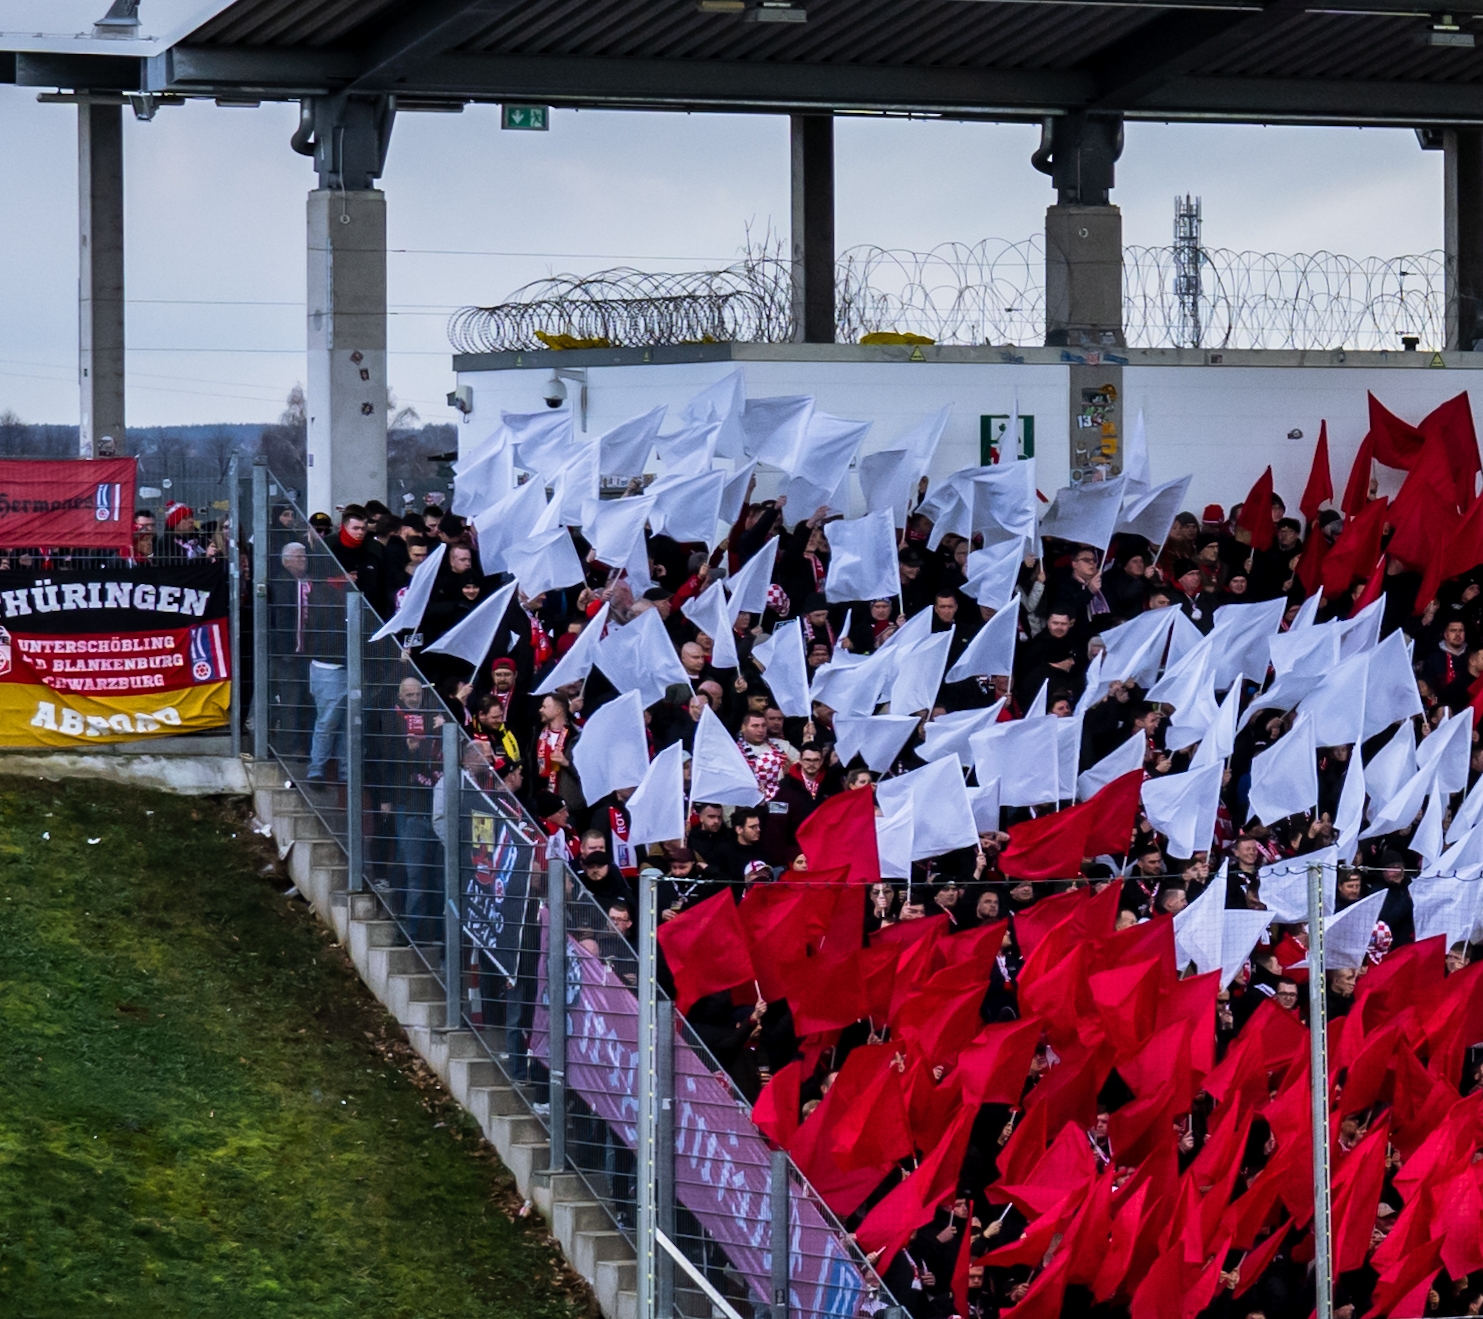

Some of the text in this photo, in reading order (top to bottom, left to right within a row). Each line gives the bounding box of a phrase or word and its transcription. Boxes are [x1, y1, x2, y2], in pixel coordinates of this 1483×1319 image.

[0, 578, 210, 618] HÜRINGEN
[17, 635, 175, 654] UNTERSCHÖBLING
[52, 653, 185, 673] BLANKENBURG
